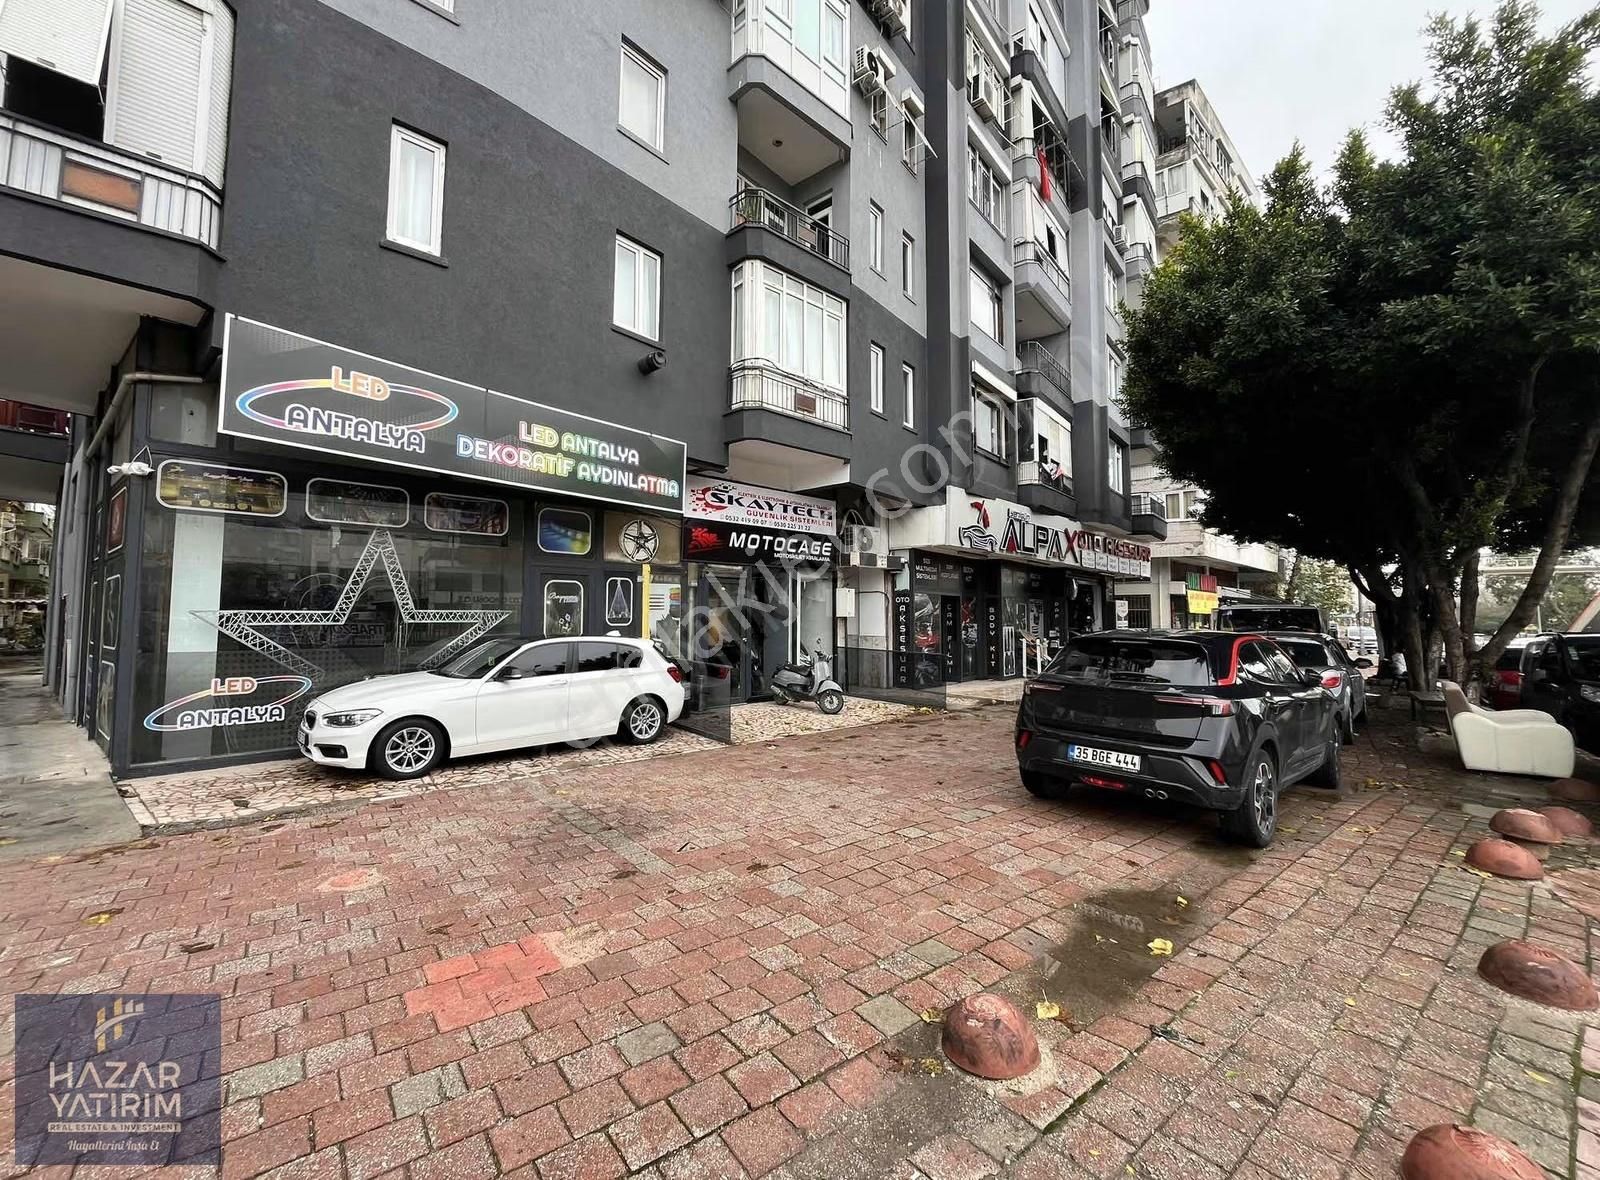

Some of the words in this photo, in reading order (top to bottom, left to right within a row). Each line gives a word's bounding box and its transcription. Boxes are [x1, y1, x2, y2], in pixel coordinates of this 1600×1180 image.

[331, 365, 390, 401] LED
[284, 403, 425, 453] ANTALYA
[518, 420, 559, 448] LED
[561, 431, 640, 465] ANTALYA
[456, 433, 576, 477] DEKORATİF
[576, 461, 680, 498] AYDINLATMA
[710, 491, 833, 520] SKAYTECH
[729, 531, 832, 556] MOTOCAGE
[1000, 517, 1079, 564] ALPAX
[899, 604, 907, 684] AKSESUAR
[211, 677, 257, 696] LED
[176, 704, 285, 730] ANTALYA
[1075, 746, 1089, 760] 35
[1091, 749, 1113, 764] BGE
[1115, 753, 1137, 769] 444
